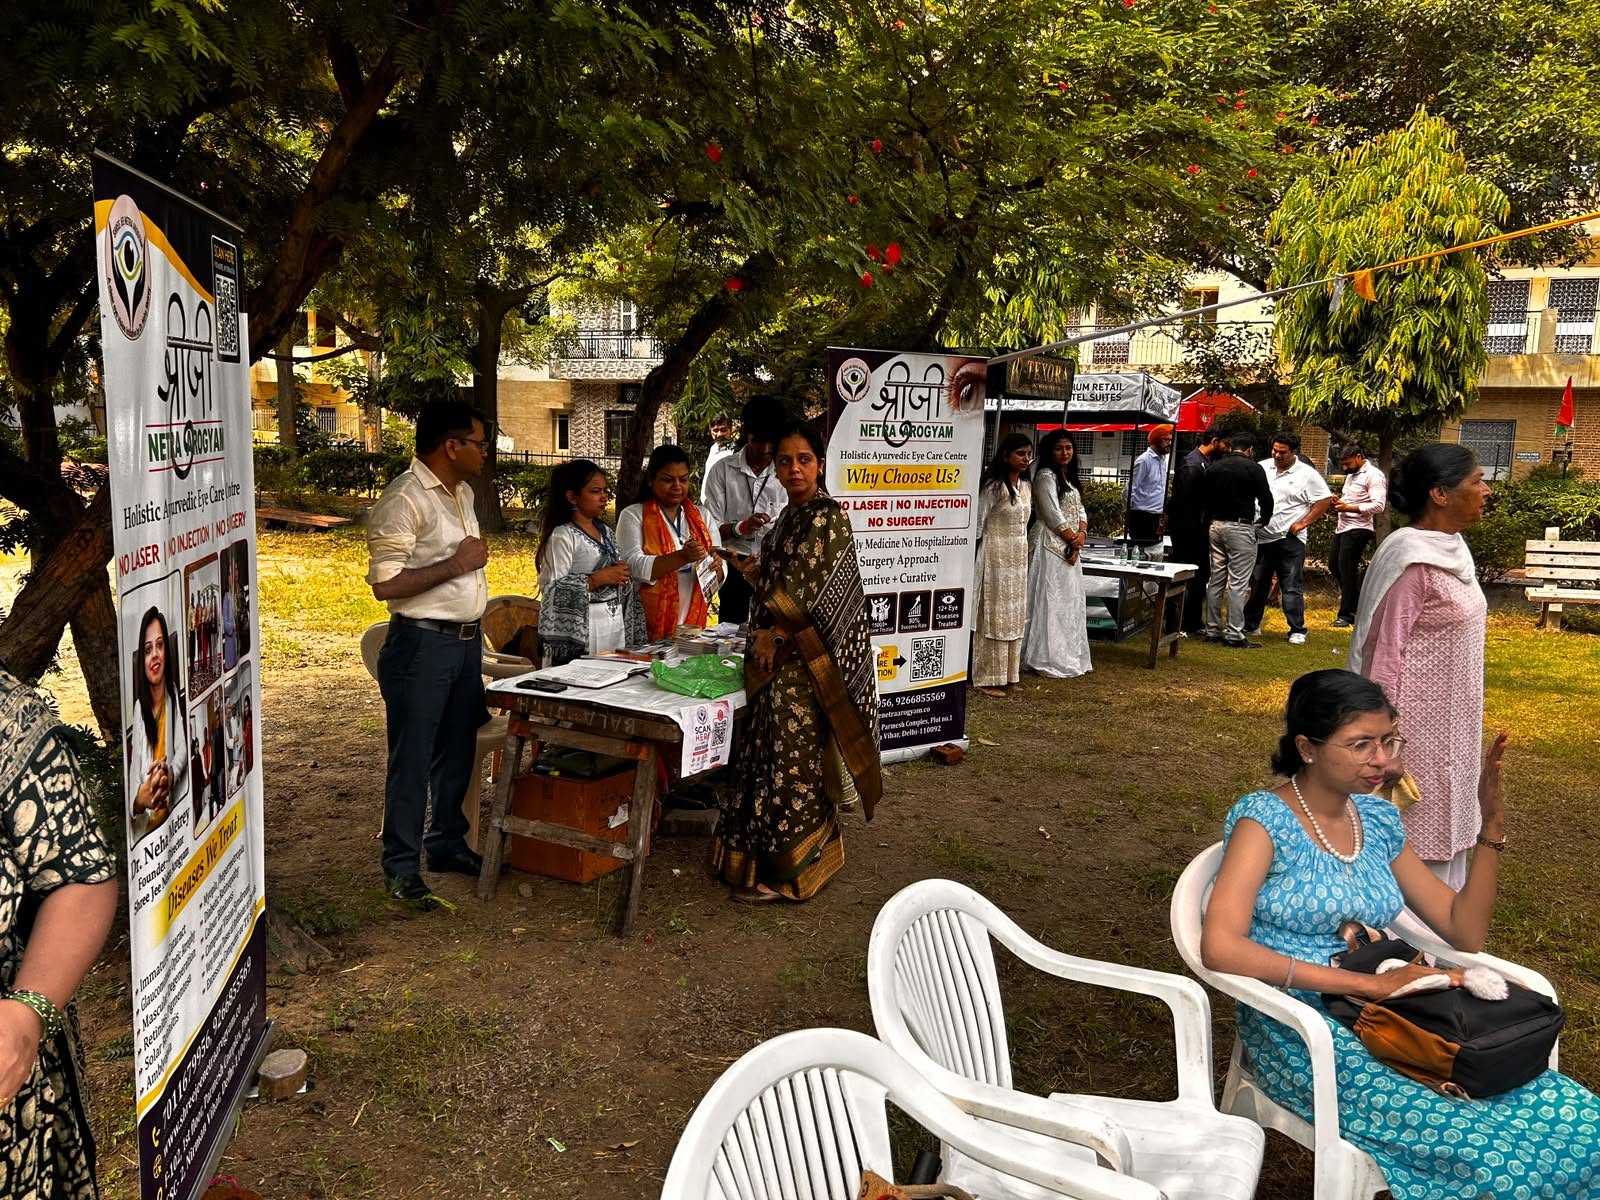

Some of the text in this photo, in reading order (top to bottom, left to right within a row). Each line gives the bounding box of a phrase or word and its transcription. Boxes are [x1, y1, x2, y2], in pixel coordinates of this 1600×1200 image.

[1092, 383, 1125, 391] RETAIL
[1072, 393, 1122, 401] TEL SUITES
[860, 423, 954, 438] NETRA AROGYAM
[148, 427, 225, 462] NETRA AROGYAM
[840, 450, 967, 463] Holistic Ayurvedic Eye Care Centre
[846, 468, 960, 489] Why Choose Us?
[123, 500, 161, 530] Holistic
[163, 491, 197, 524] Ayurvedic
[197, 489, 209, 513] Eye
[209, 486, 225, 504] Care
[853, 500, 888, 511] LASER
[896, 499, 911, 510] NO
[914, 498, 968, 510] INJECTION
[868, 516, 935, 527] NO SURGERY
[119, 554, 129, 578] NO
[131, 544, 160, 572] LASER
[168, 537, 176, 559] NO
[177, 524, 210, 553] INJECTION
[216, 520, 225, 538] NO
[865, 537, 900, 550] Medicine
[901, 537, 913, 548] No
[914, 535, 968, 550] Hospitalization
[860, 552, 939, 570] Surgery Approach
[861, 574, 891, 586] entive
[900, 571, 937, 584] Curative
[948, 604, 958, 612] Eye
[938, 620, 958, 628] Treated
[895, 691, 946, 706] 9266855569
[694, 724, 712, 735] SCAN
[881, 722, 905, 731] Parmesh
[905, 718, 929, 728] Complex,
[901, 725, 942, 737] Delhi-110092
[131, 858, 143, 880] Dr.
[144, 835, 169, 865] Neha
[168, 812, 238, 921] Diseases We Treat
[134, 891, 150, 915] Shree
[151, 883, 162, 902] Jee
[162, 955, 252, 1130] 7011679956, 9266855569
[144, 1043, 162, 1071] Solar
